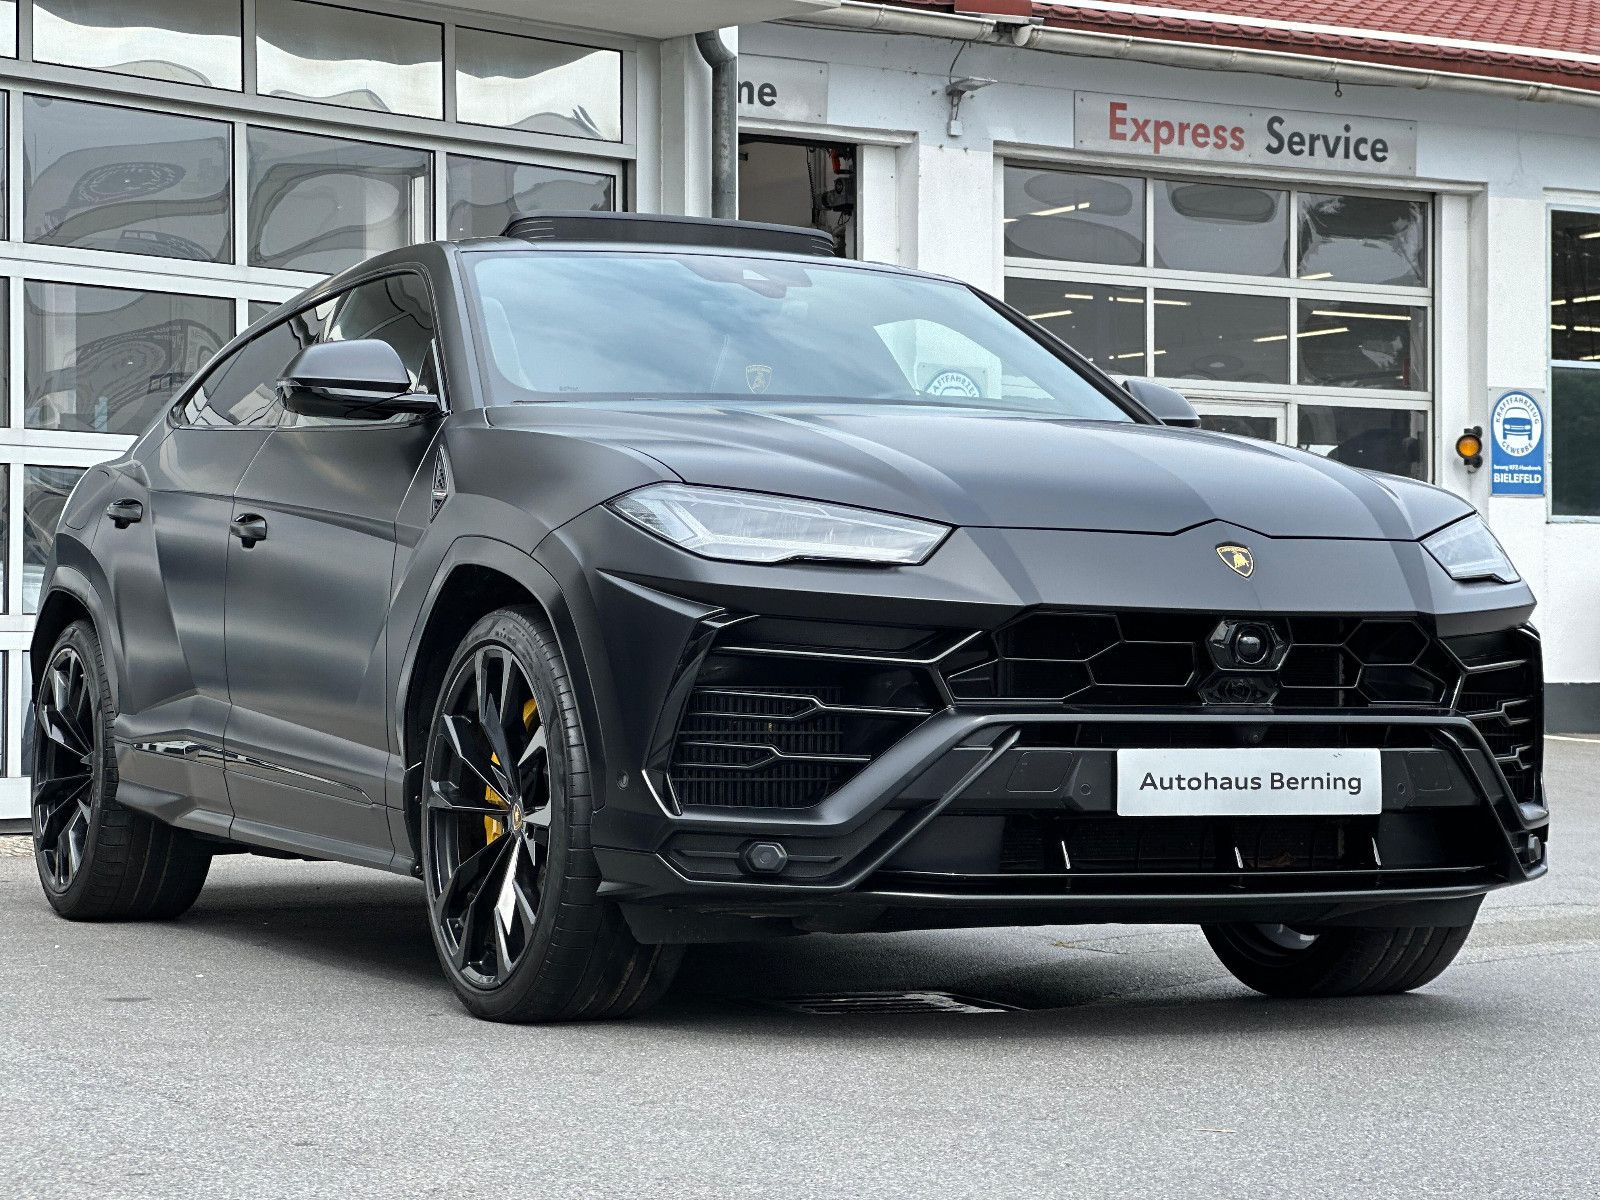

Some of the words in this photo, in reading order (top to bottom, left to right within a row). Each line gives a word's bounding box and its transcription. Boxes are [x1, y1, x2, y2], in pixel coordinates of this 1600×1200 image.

[1109, 101, 1245, 154] Express
[1265, 115, 1389, 163] Service
[1495, 396, 1540, 425] KRAFTFAHRZEUG
[1501, 440, 1533, 455] GEWERBE
[1493, 472, 1542, 484] BIELEFELD
[1139, 772, 1262, 791] Autohaus
[1270, 772, 1362, 795] Berning
